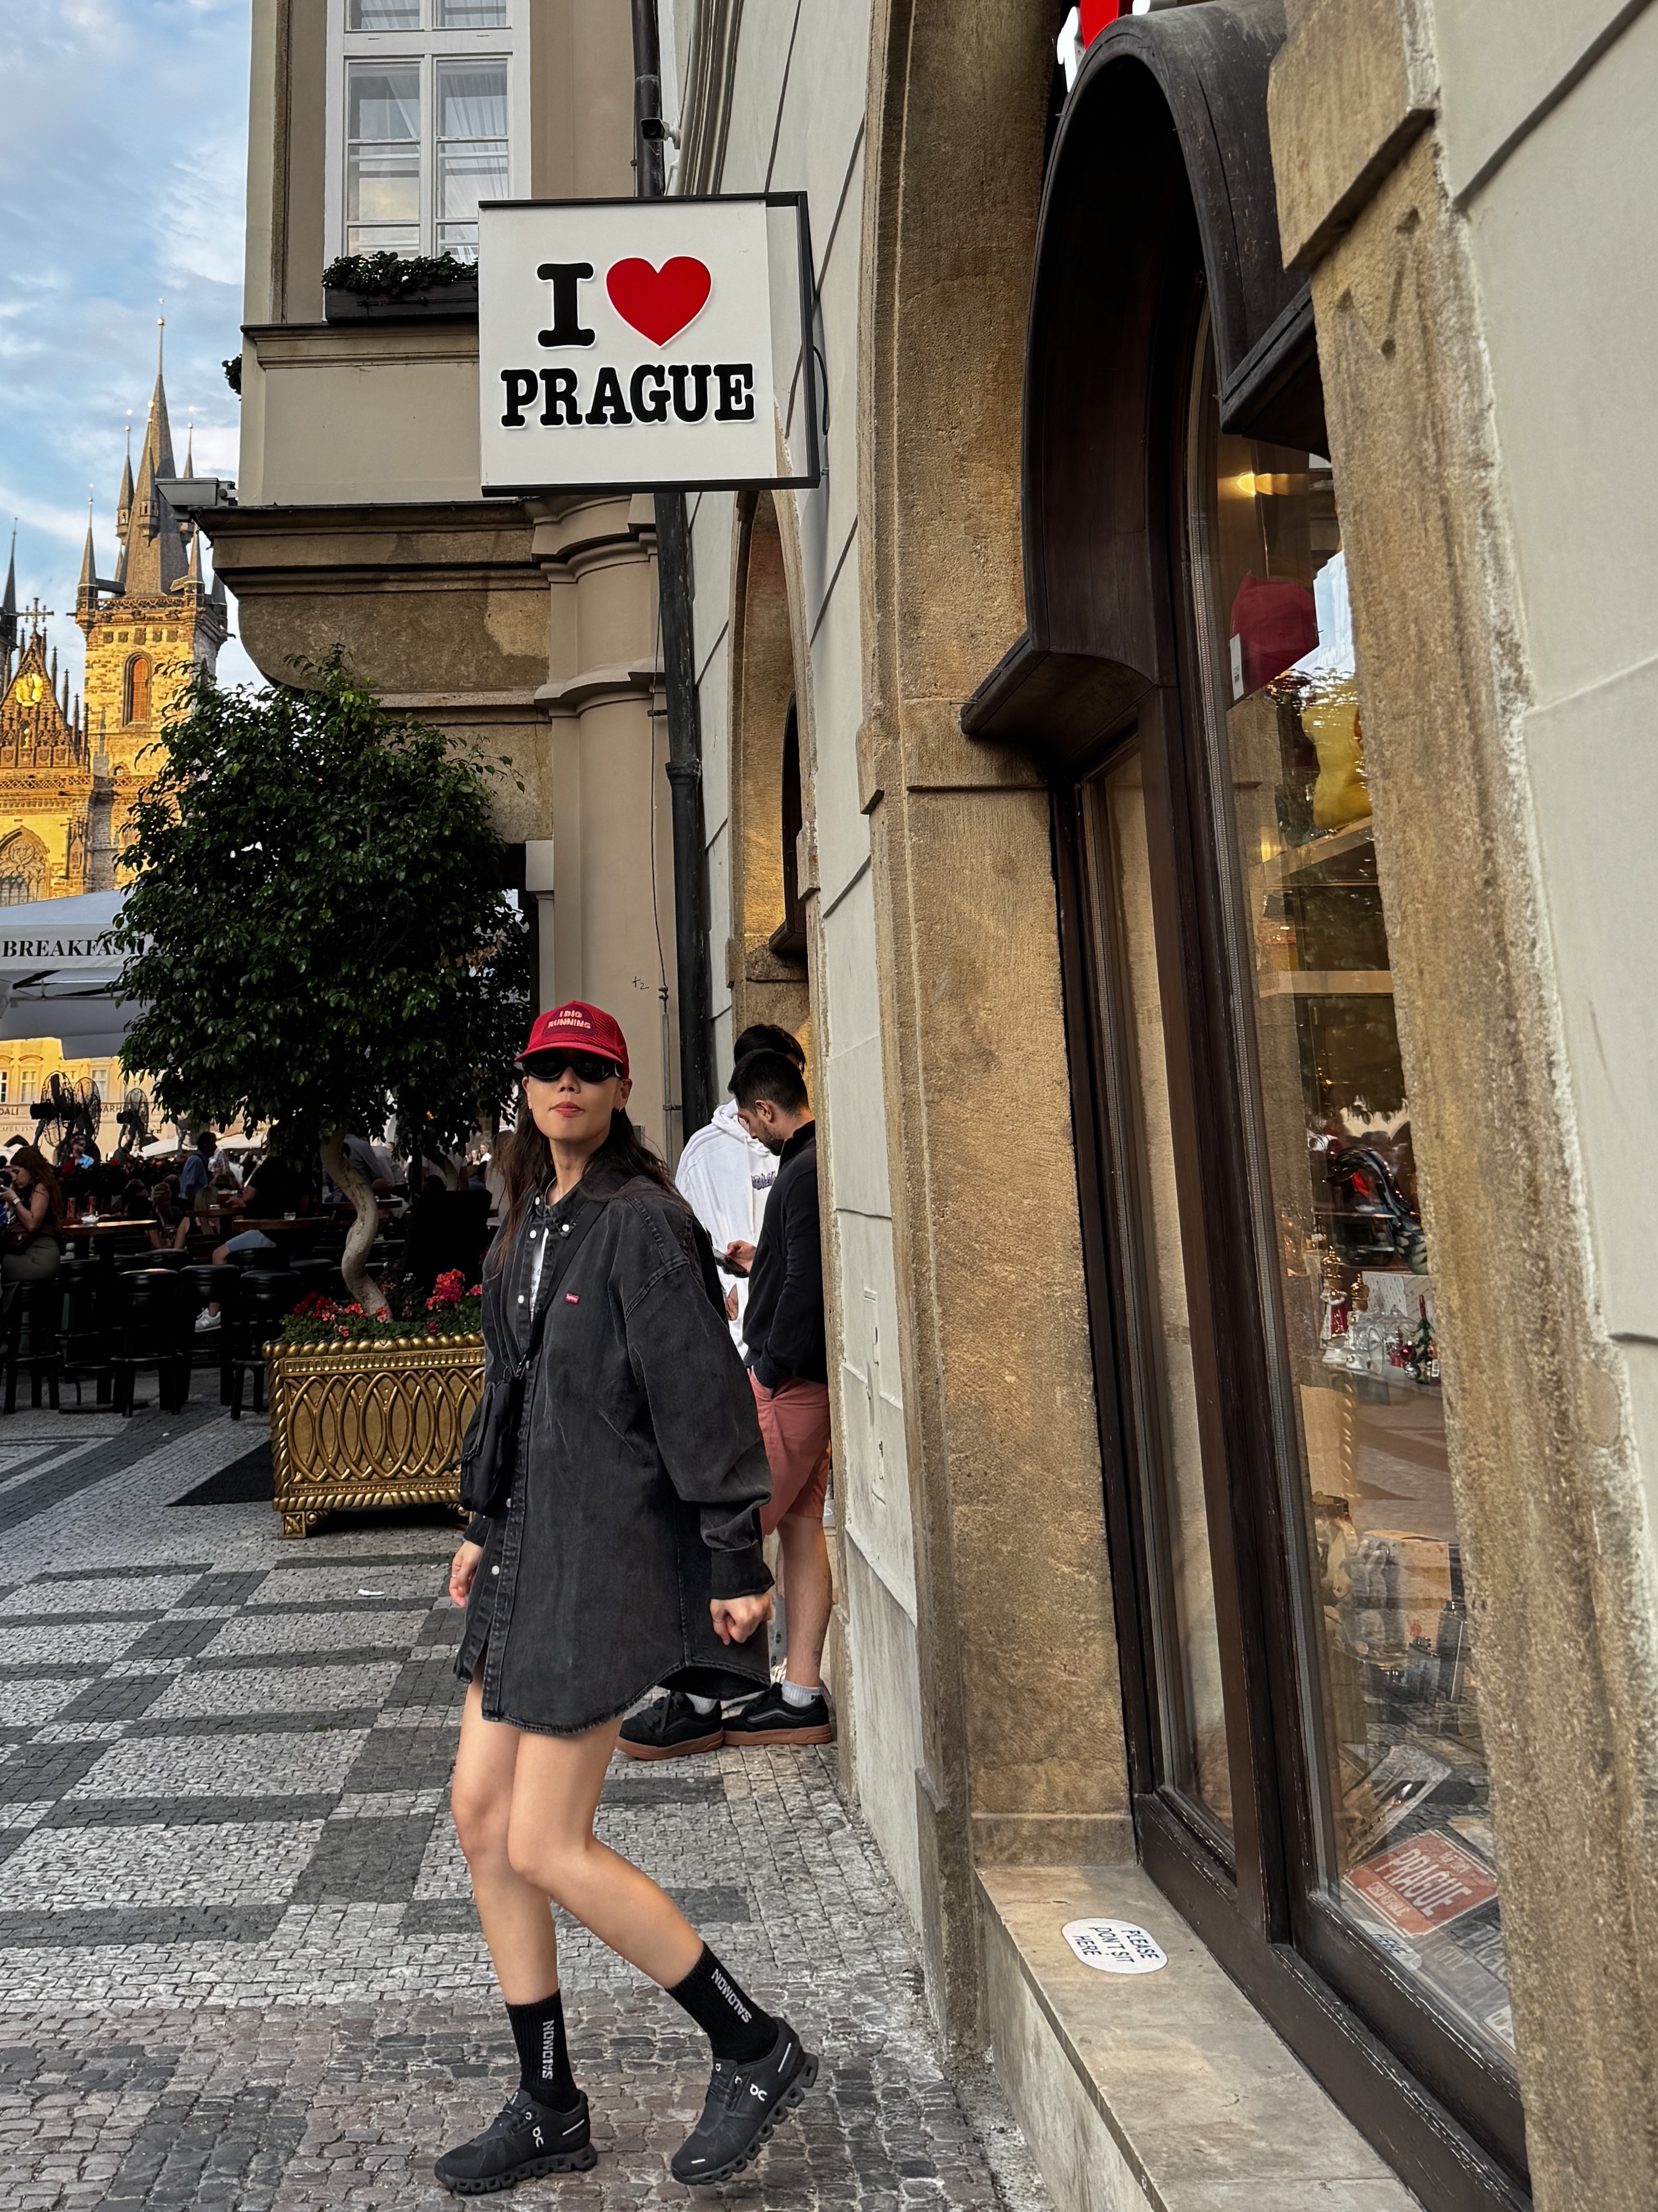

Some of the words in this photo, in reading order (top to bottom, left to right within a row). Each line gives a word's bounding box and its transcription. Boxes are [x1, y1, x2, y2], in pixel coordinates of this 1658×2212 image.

[537, 262, 595, 347] I
[501, 364, 755, 427] PRAGUE
[548, 1019, 591, 1029] RUNNING
[1375, 1848, 1472, 1917] PRAGUE
[1072, 1935, 1102, 1955] HERE
[1111, 1951, 1135, 1962] SIT
[1121, 1930, 1160, 1958] PLEASE
[711, 1969, 752, 2023] SALOMON
[542, 2020, 554, 2079] SALOMON
